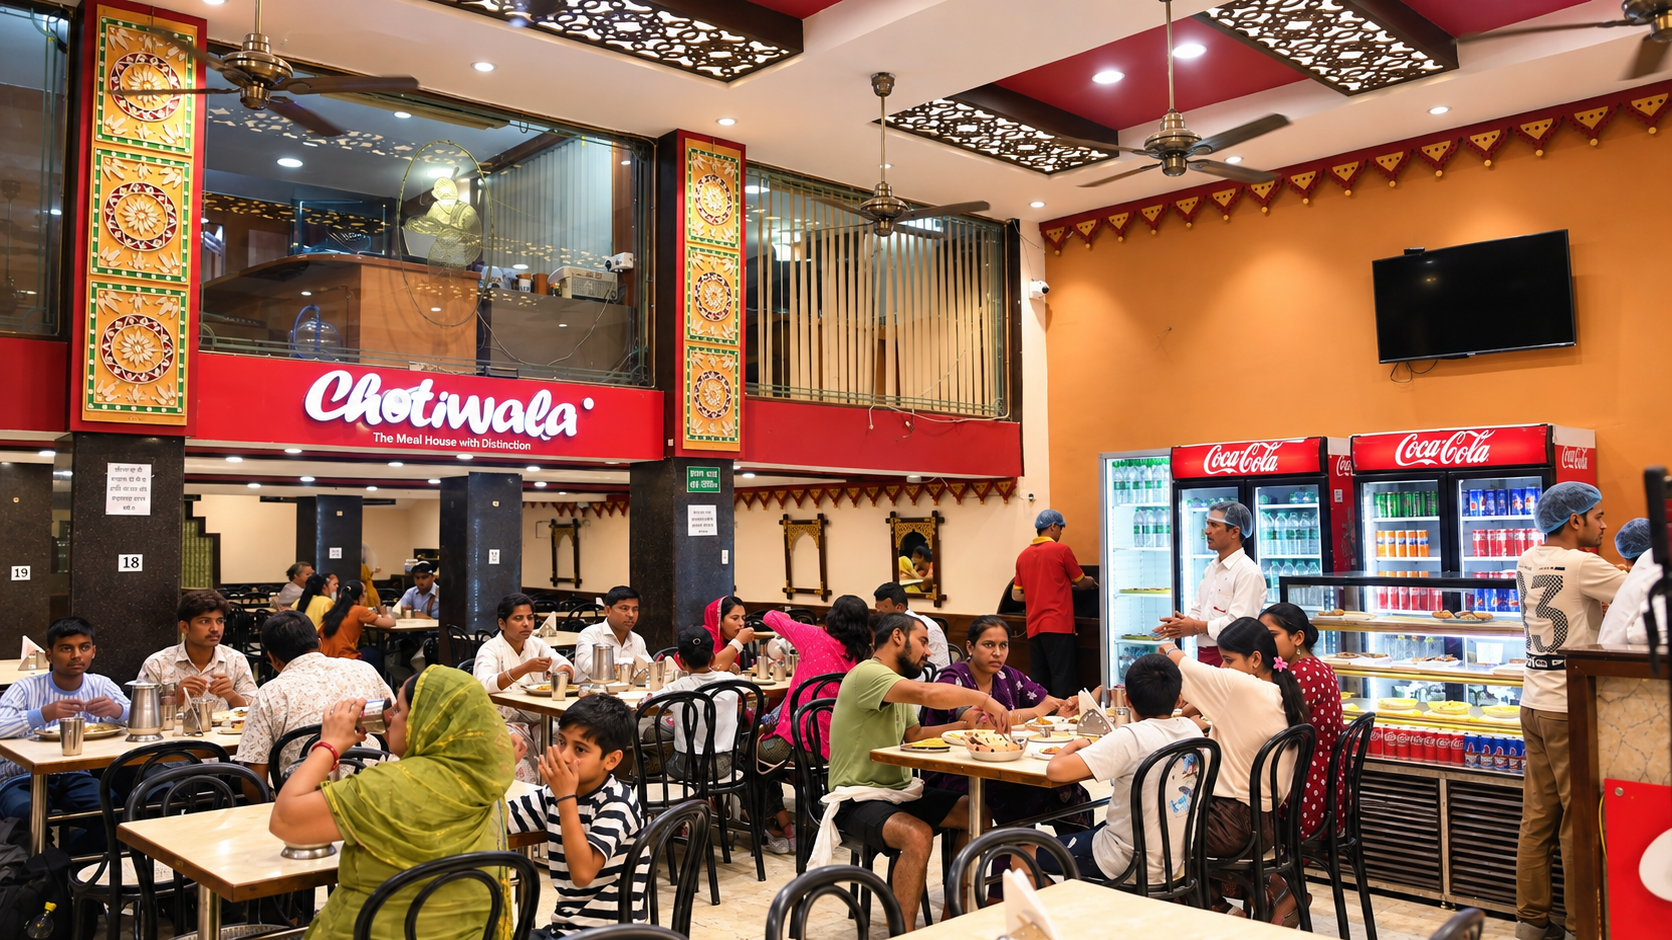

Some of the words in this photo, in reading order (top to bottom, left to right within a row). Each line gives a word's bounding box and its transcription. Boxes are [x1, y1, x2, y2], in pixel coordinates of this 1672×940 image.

[304, 370, 577, 439] Chotiwala
[373, 432, 394, 443] The
[396, 433, 423, 445] Meal
[425, 435, 457, 447] House
[459, 438, 480, 448] with
[482, 438, 531, 450] Distinction
[1395, 430, 1495, 466] Coca-Cola
[1203, 441, 1284, 475] Coca-Cola
[14, 567, 29, 578] 19
[122, 556, 140, 569] 18
